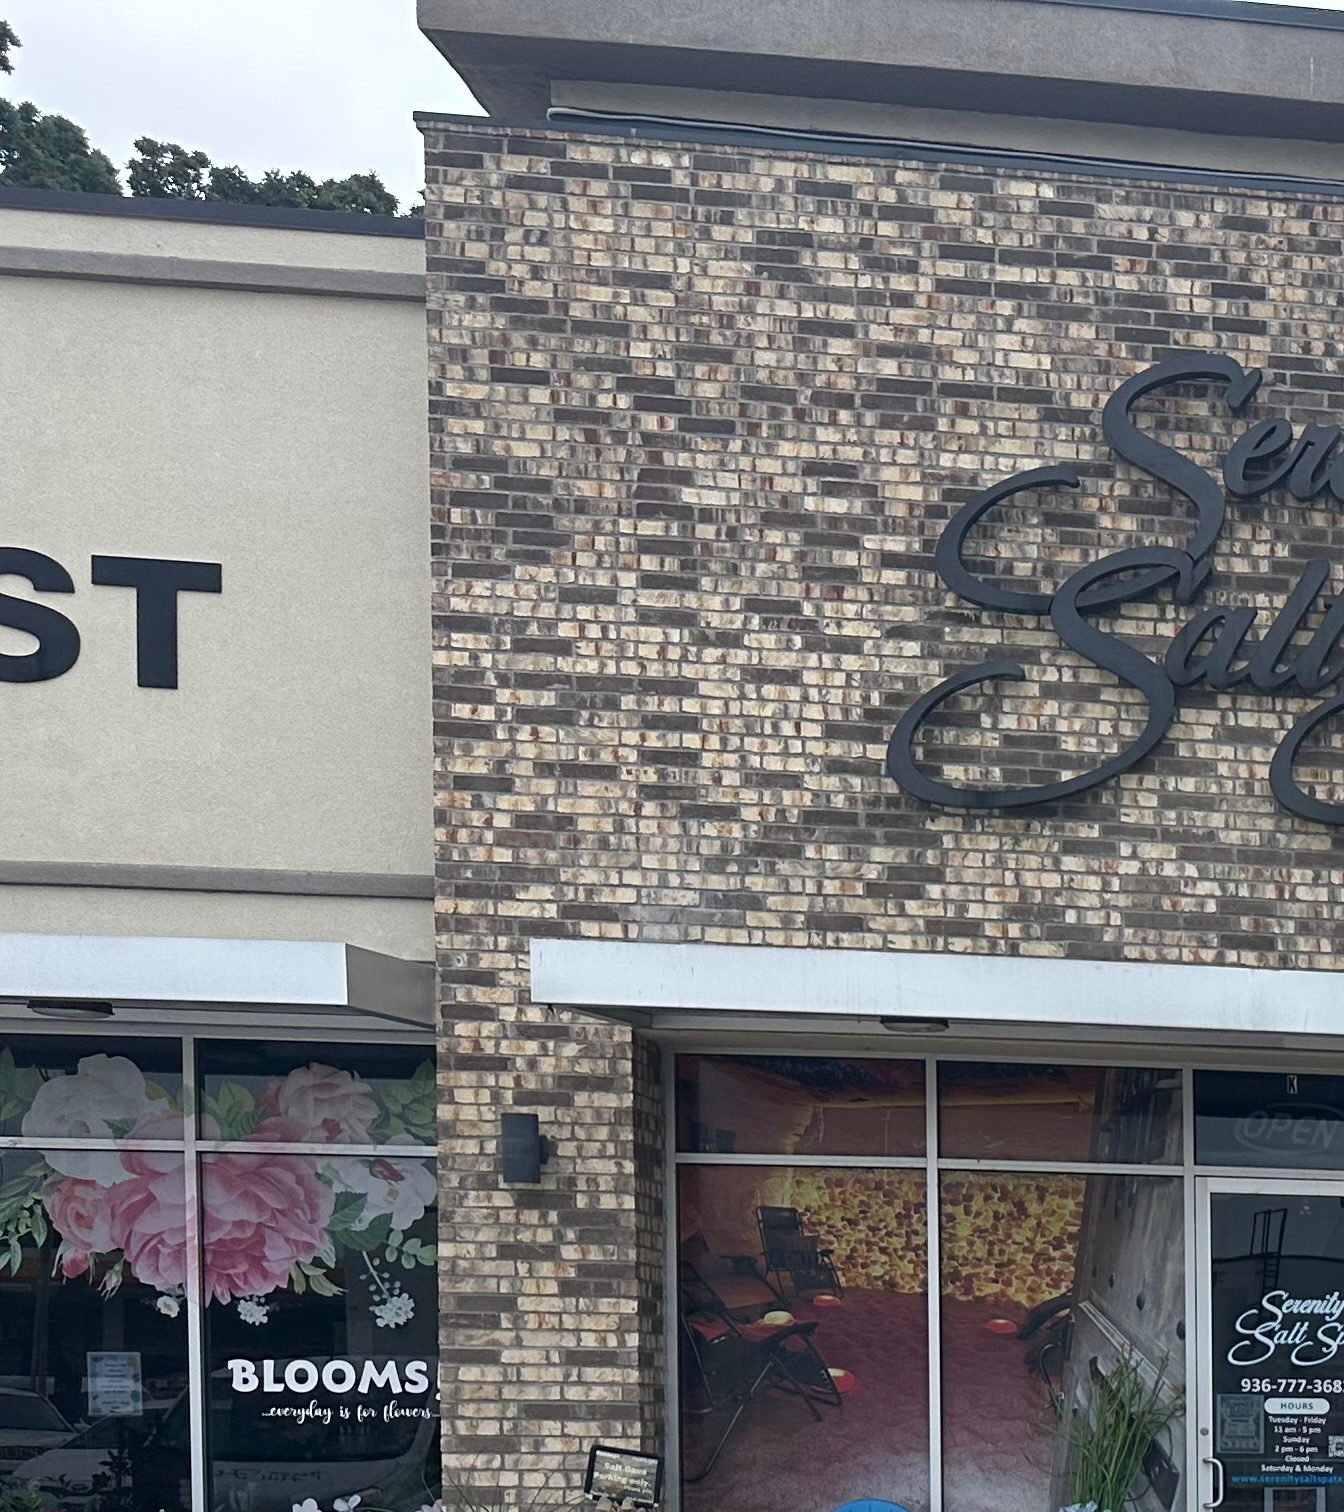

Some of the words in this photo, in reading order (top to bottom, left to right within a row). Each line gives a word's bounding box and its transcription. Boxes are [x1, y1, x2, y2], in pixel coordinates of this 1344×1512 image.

[0, 547, 222, 689] ST
[1287, 1075, 1297, 1094] K
[1242, 1110, 1341, 1149] OPEN
[1227, 1321, 1309, 1366] Salt
[339, 1405, 350, 1418] is
[357, 1404, 377, 1422] for
[1280, 1402, 1313, 1410] HOURS
[1268, 1415, 1298, 1425] Tuesday
[1303, 1416, 1326, 1425] Friday
[1261, 1464, 1294, 1473] Saturday
[1303, 1465, 1333, 1473] Monday
